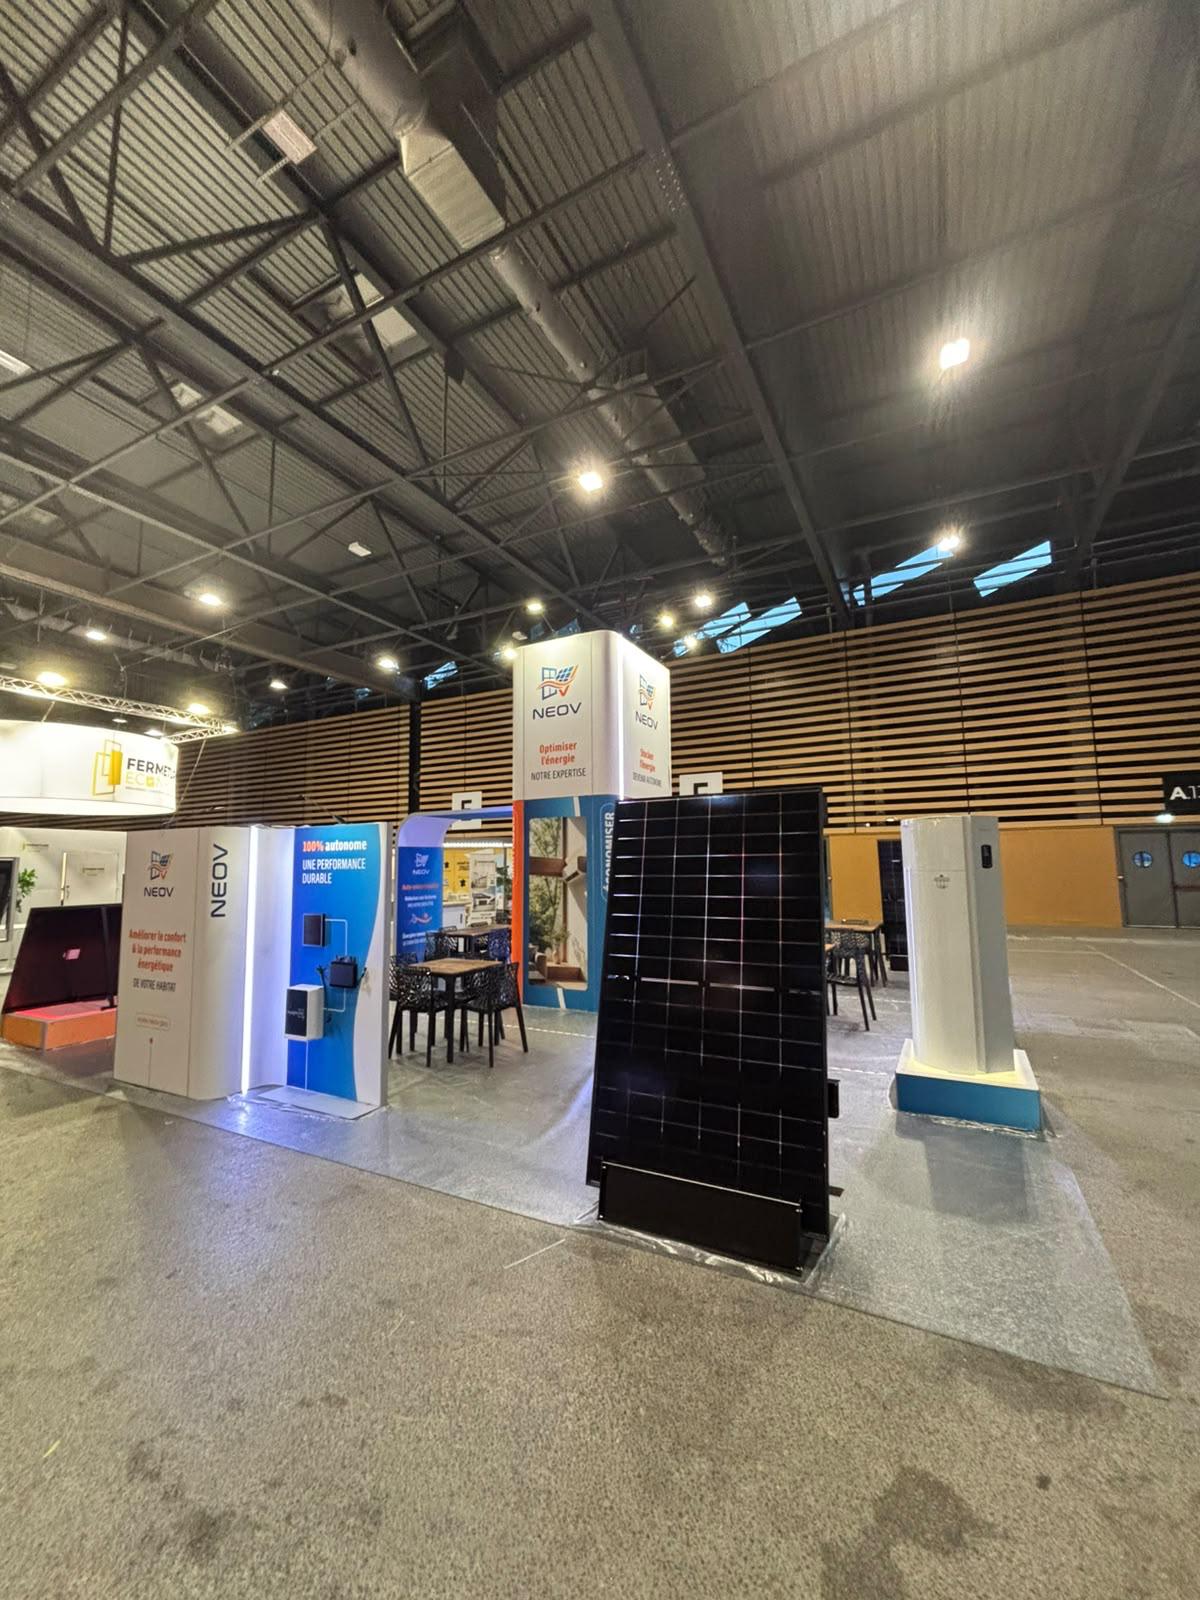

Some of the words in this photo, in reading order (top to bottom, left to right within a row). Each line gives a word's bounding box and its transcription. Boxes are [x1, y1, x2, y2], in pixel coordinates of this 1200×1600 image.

[532, 702, 582, 720] NEOV
[635, 711, 658, 730] NEOV
[539, 742, 577, 754] Optimiser
[531, 771, 551, 780] NOTRE
[552, 768, 586, 779] EXPERTISE
[303, 840, 324, 852] 100%
[325, 839, 367, 851] autonome
[302, 858, 316, 870] UNE
[317, 857, 366, 870] PERFORMANCE
[211, 843, 228, 917] NEOV
[302, 872, 332, 884] DURABLE
[144, 887, 174, 897] NEOV
